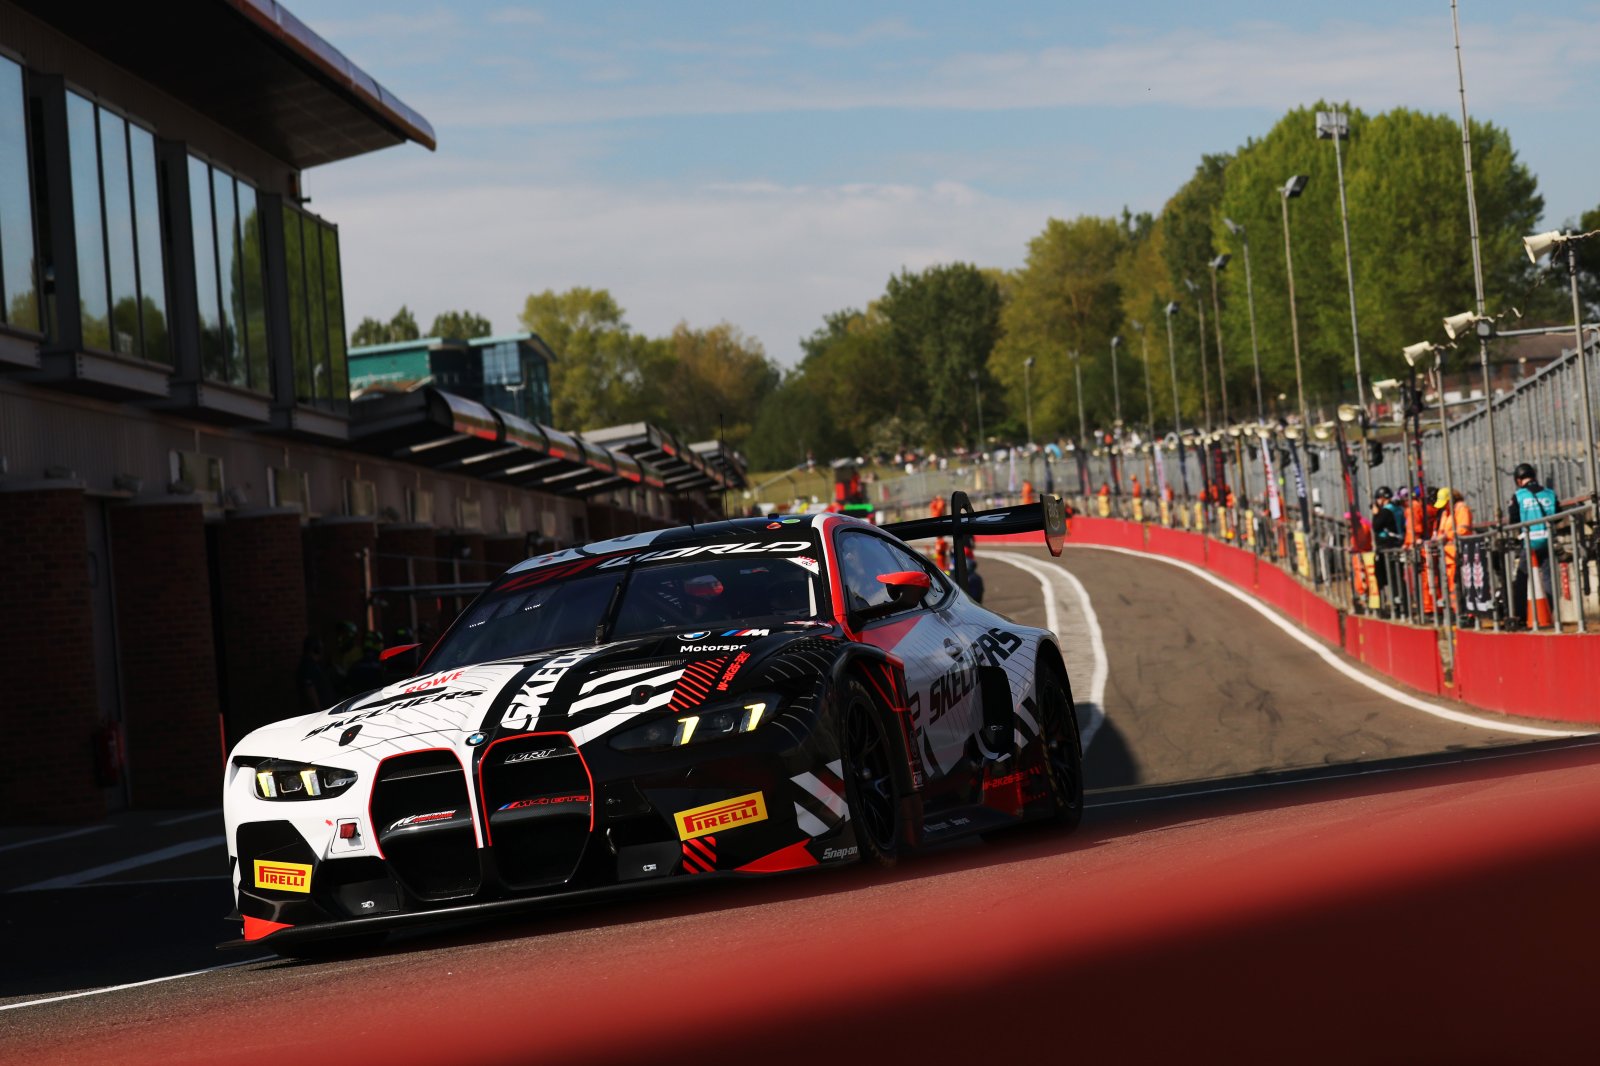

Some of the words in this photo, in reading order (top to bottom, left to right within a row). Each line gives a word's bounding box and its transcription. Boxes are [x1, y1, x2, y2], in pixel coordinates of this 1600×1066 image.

[597, 541, 812, 570] WORLD
[404, 670, 466, 695] ROWE
[304, 690, 484, 739] SKECHERS
[504, 748, 557, 764] WRT
[684, 799, 759, 834] PIRELLI
[823, 846, 858, 861] Snap-on
[258, 866, 307, 887] PIRELLI
